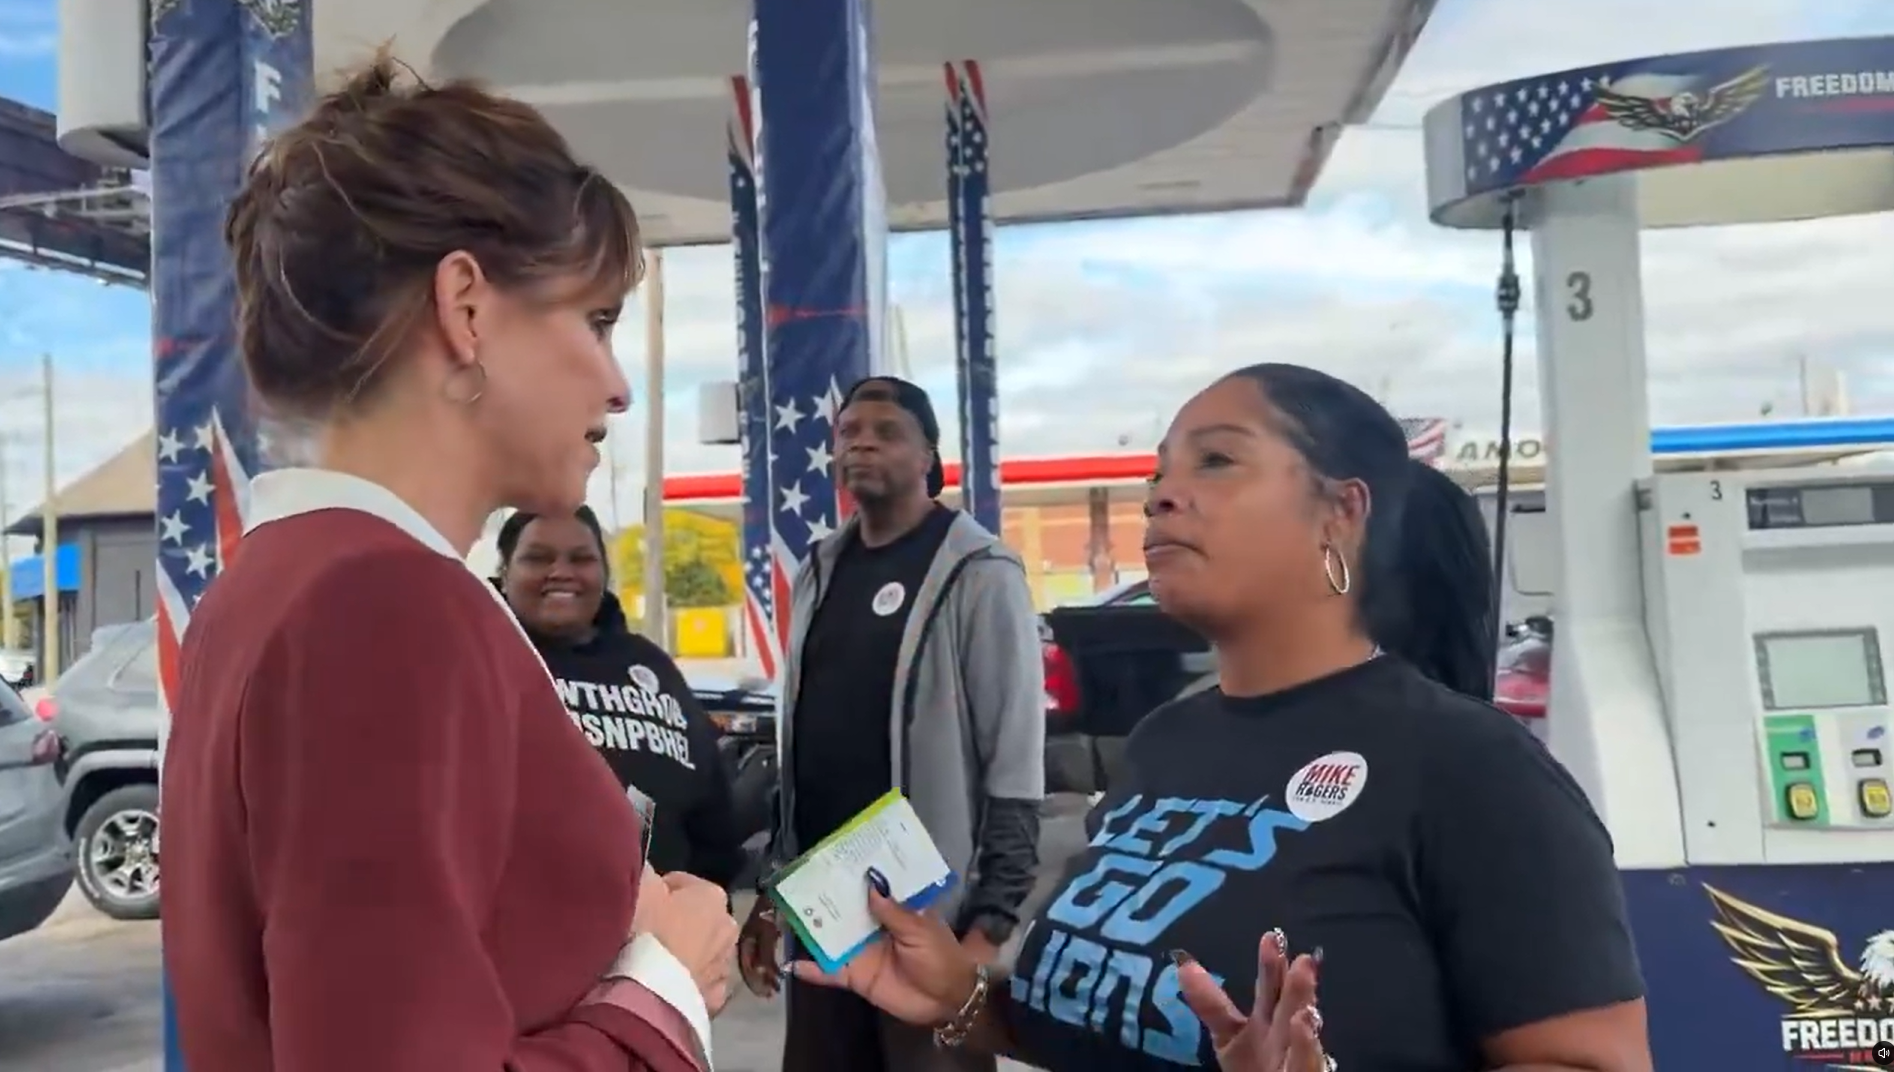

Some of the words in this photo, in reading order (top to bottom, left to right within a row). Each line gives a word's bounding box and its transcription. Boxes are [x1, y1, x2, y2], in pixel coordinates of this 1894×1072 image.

[1775, 70, 1894, 99] FREEDOM
[1566, 271, 1594, 321] 3
[1710, 480, 1723, 500] 3
[1303, 764, 1360, 786] MIKE
[1295, 781, 1348, 801] ROGERS
[1088, 794, 1312, 870] LET'S
[1047, 852, 1227, 946] GO
